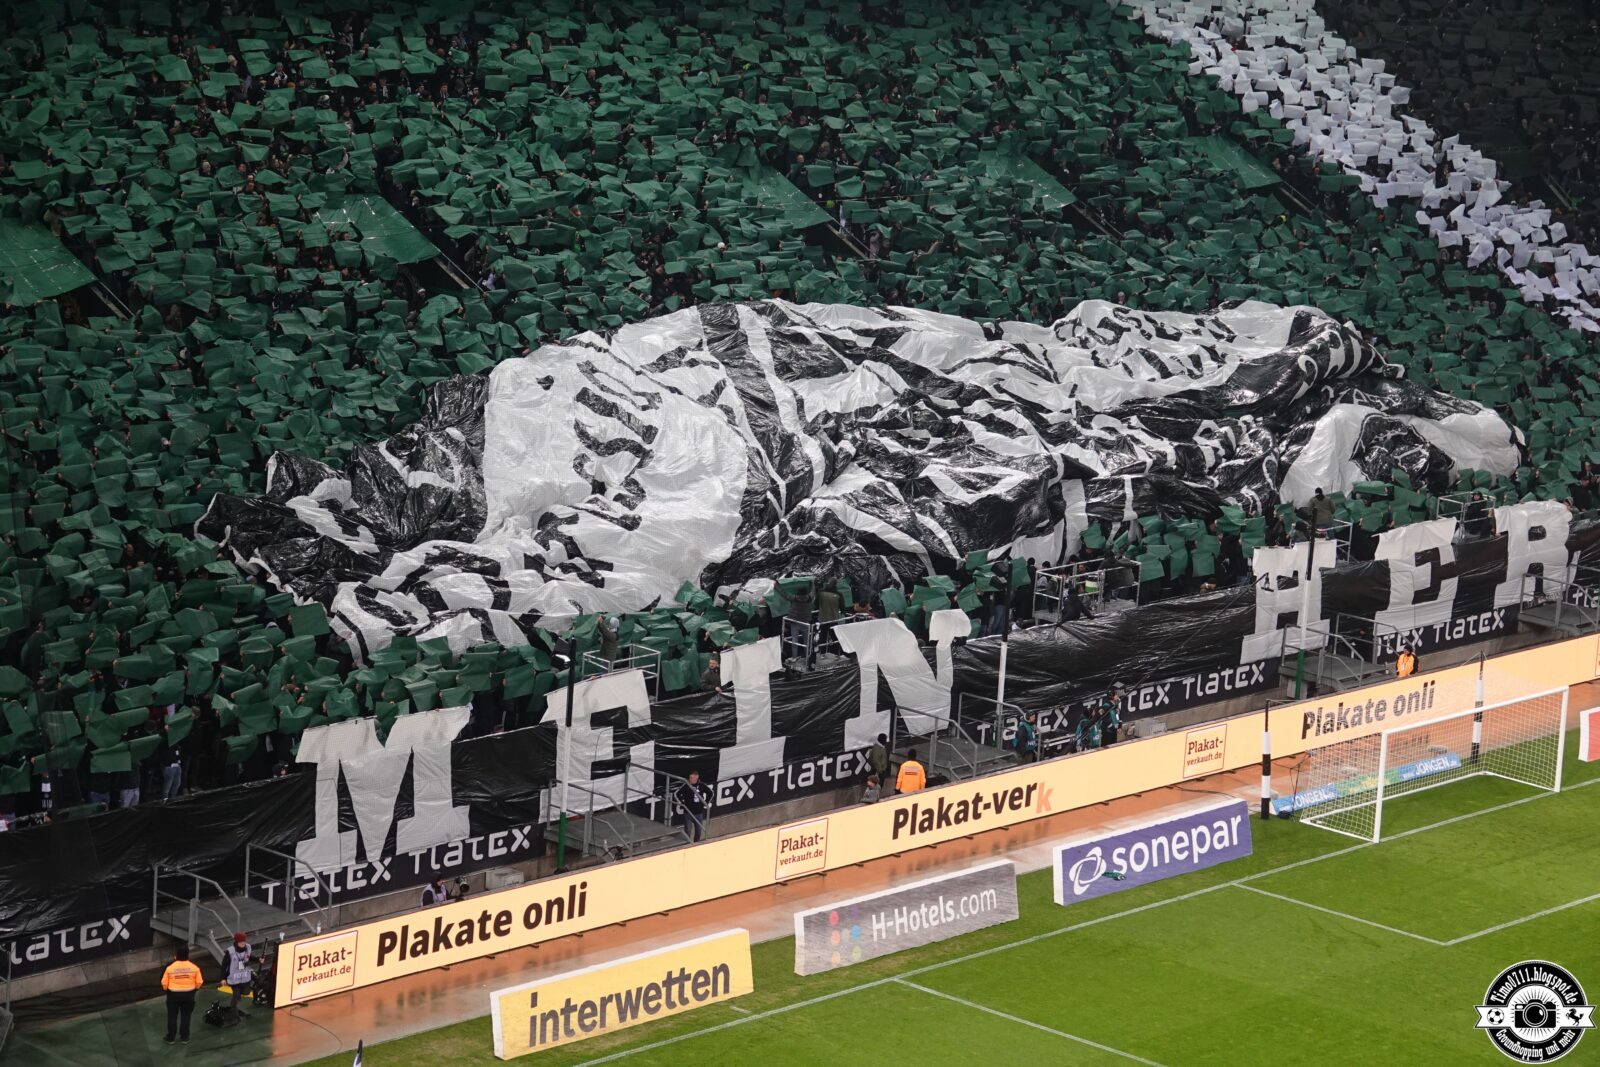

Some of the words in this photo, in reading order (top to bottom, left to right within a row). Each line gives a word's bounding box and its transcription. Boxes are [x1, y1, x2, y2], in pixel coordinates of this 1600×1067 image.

[1301, 697, 1387, 740] Plakate
[1393, 680, 1436, 717] onli
[1187, 736, 1224, 756] Plakat-
[1187, 750, 1223, 767] verkauft.de
[892, 782, 1054, 840] Plakat-verk
[779, 848, 824, 867] verkauft.de
[780, 832, 825, 854] Plakat-
[1112, 814, 1242, 875] sonepar
[376, 908, 513, 967] Plakate
[523, 881, 588, 930] onli
[871, 888, 997, 942] H-Hotels.com
[296, 964, 352, 986] verkauft.de
[297, 947, 353, 972] Plakat-
[529, 962, 731, 1048] interwetten
